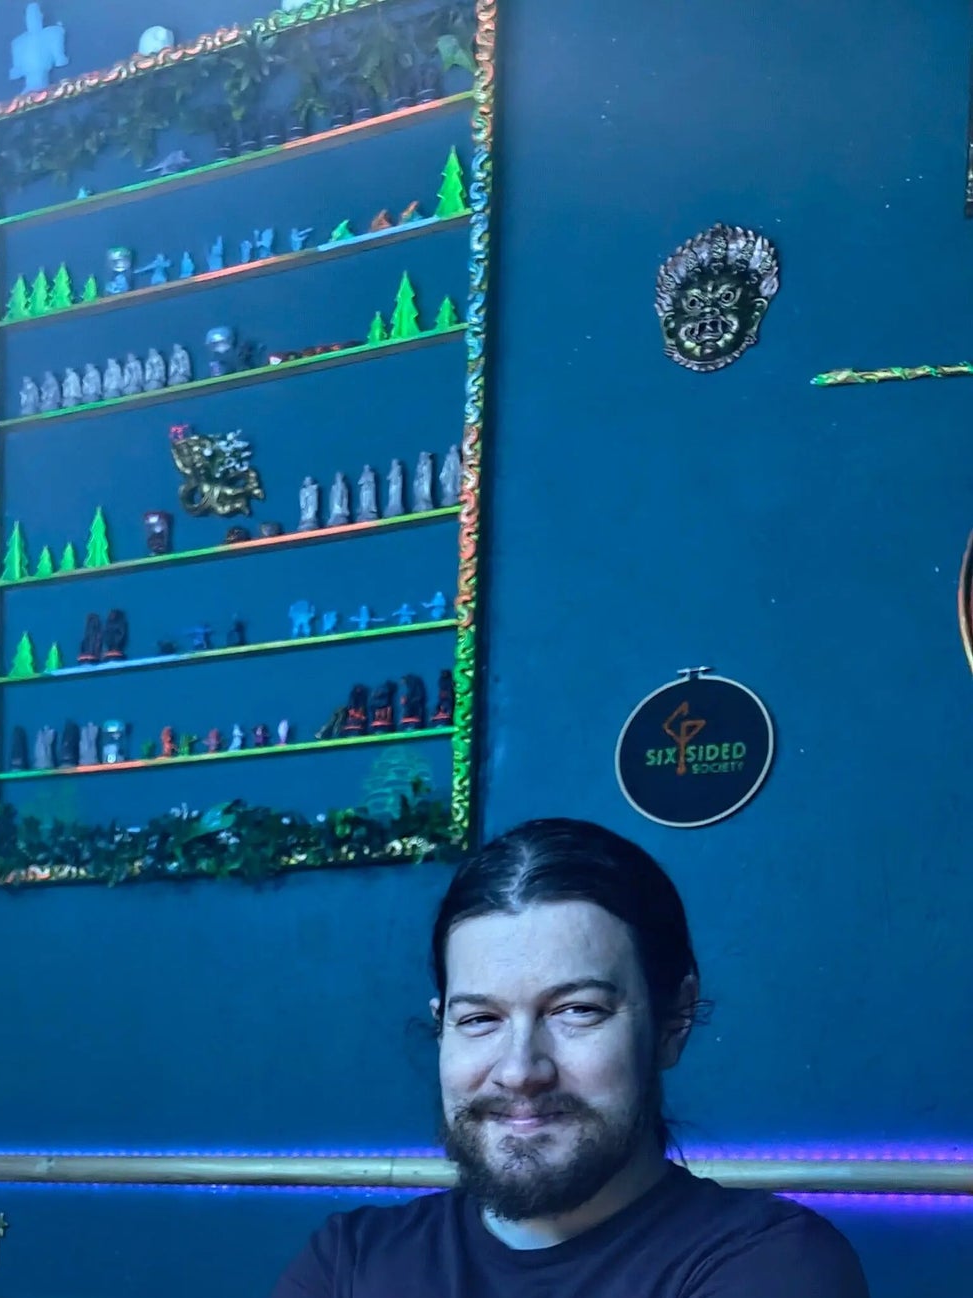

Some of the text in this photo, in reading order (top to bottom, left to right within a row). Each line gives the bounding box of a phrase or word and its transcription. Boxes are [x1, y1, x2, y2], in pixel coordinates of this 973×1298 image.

[645, 742, 746, 766] SIX SIDED
[692, 761, 745, 774] SOCIETY
